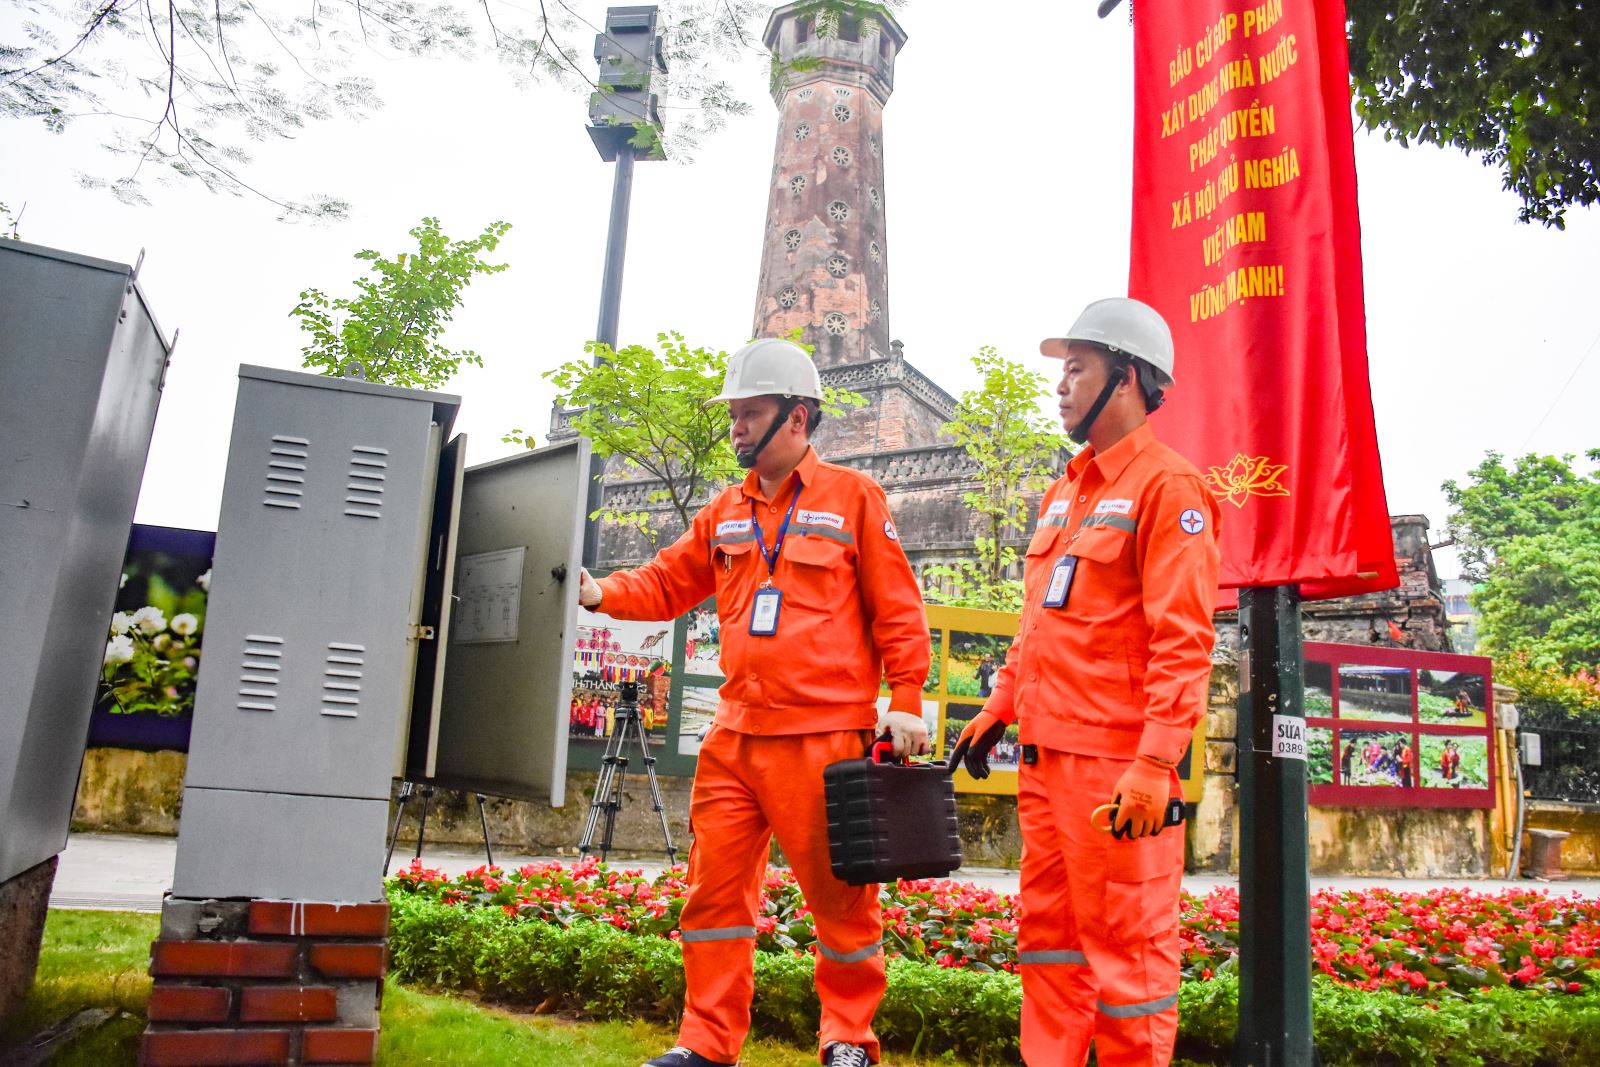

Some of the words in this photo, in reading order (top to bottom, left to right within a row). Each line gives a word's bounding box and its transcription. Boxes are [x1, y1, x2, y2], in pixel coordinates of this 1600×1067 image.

[1169, 43, 1192, 88] BẦU
[1196, 25, 1212, 68] CỬ
[1213, 12, 1237, 53] GÓP
[1161, 99, 1184, 138] XÂY
[1188, 75, 1218, 123] DỰNG
[1219, 53, 1255, 96] NHÀ
[1259, 33, 1297, 84] NƯỚC
[1189, 126, 1218, 172] PHÁP
[1219, 98, 1275, 148] QUYỀN
[1171, 191, 1192, 229] XÃ
[1195, 179, 1216, 220] HỘI
[1217, 153, 1239, 204] CHỦ
[1244, 145, 1300, 189] NGHĨA
[1203, 224, 1225, 267] VIỆT
[1225, 212, 1266, 250] NAM
[1190, 283, 1226, 322] VỮNG
[1226, 265, 1284, 305] MẠNH!
[1277, 720, 1301, 740] SỬA
[1278, 742, 1303, 755] 0389
